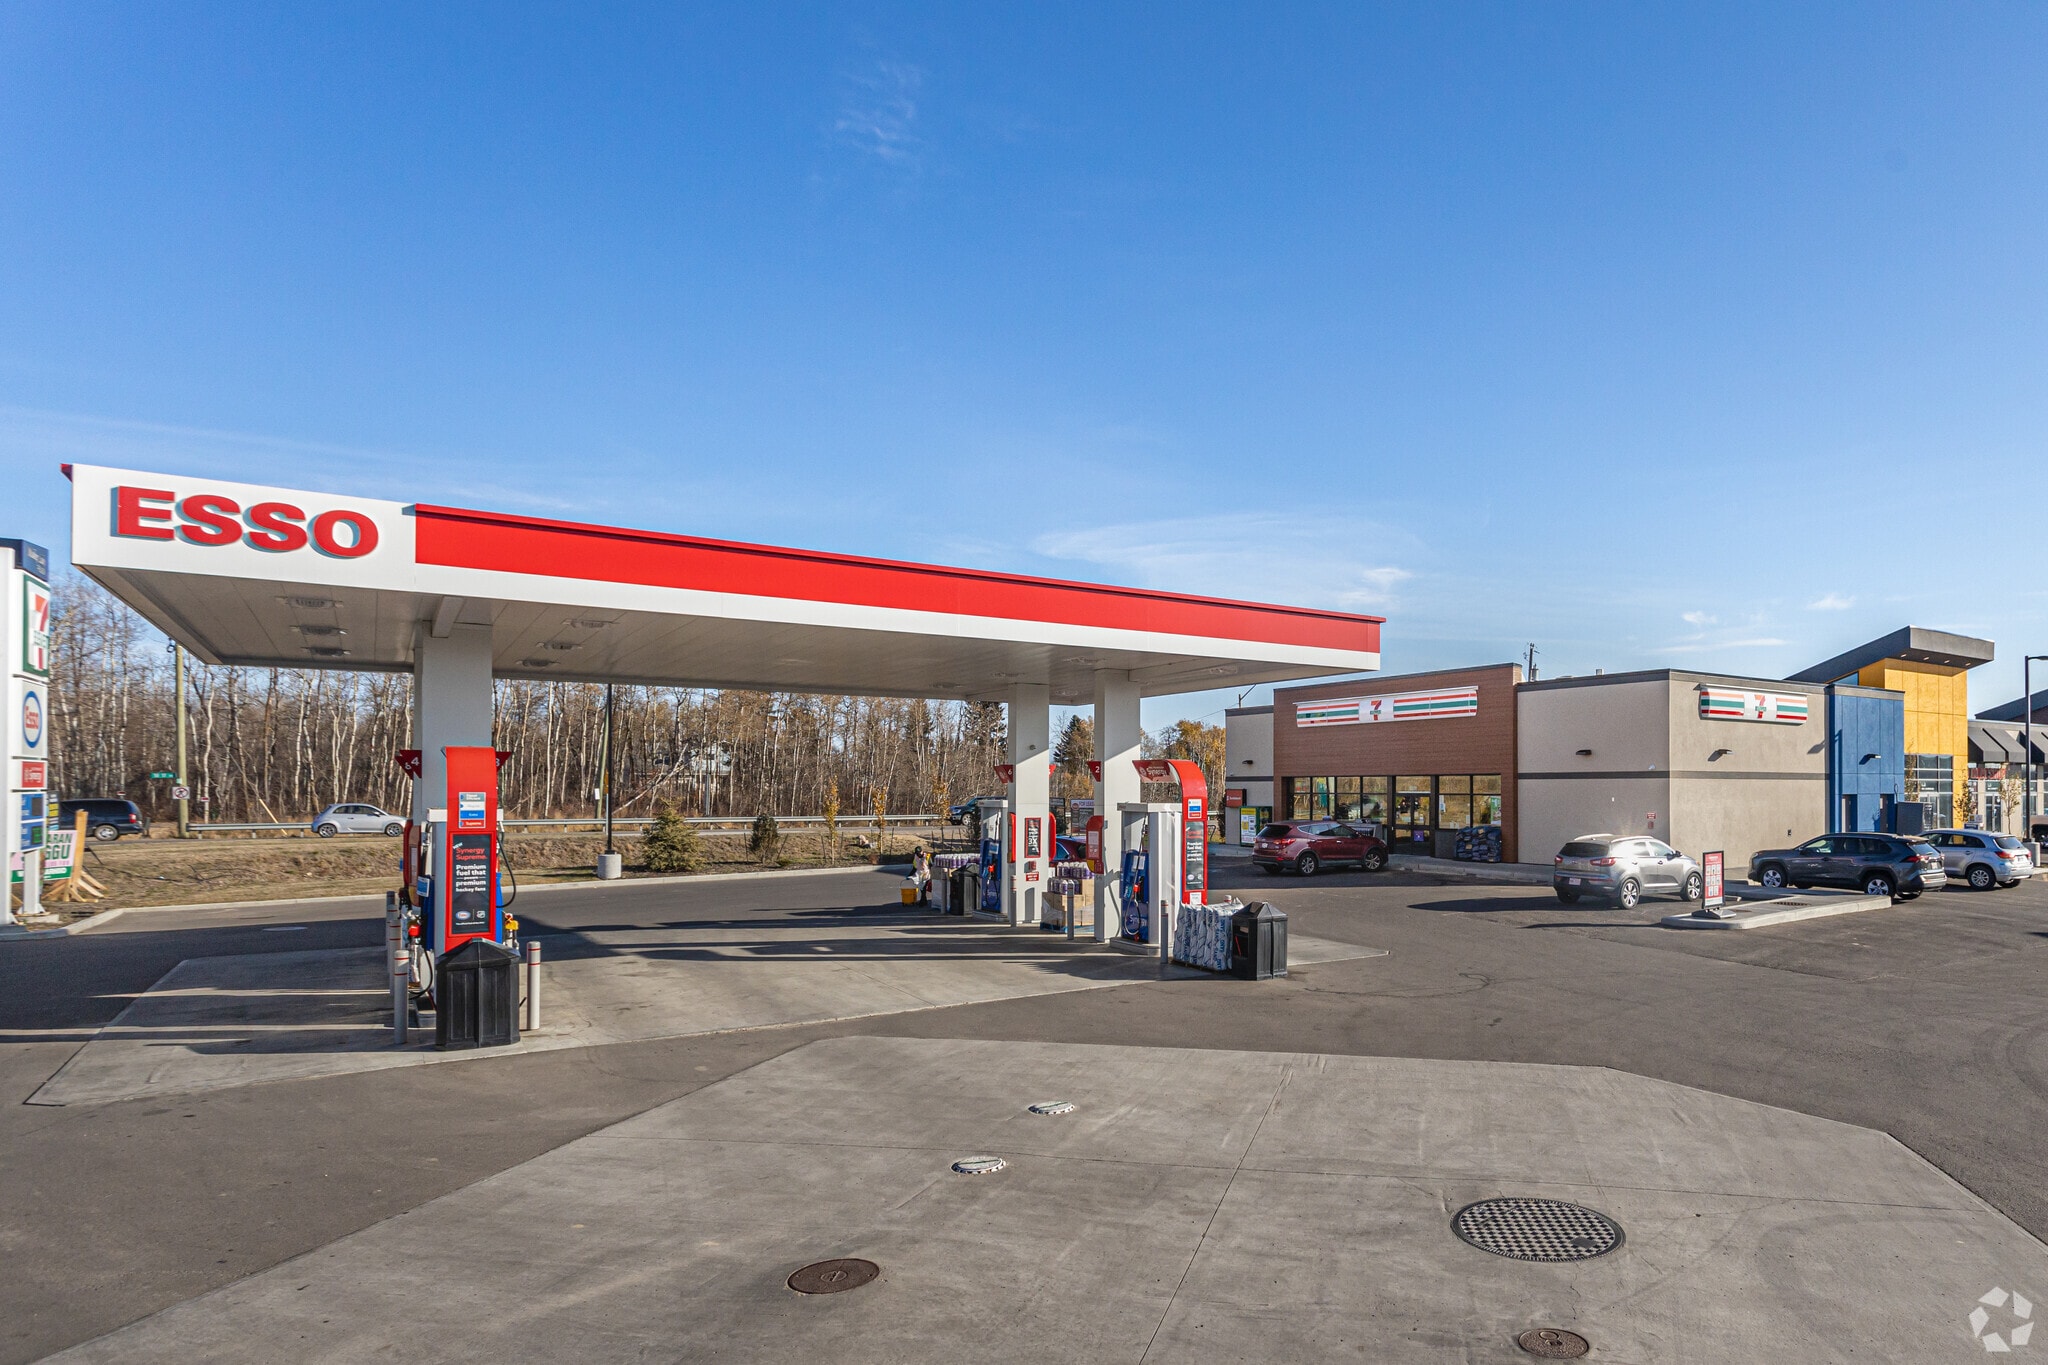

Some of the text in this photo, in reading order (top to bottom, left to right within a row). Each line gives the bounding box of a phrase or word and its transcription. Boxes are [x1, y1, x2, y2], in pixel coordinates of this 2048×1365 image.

[110, 485, 379, 560] ESSO
[35, 594, 48, 670] 7
[1370, 699, 1382, 721] 7
[1754, 694, 1766, 719] 7
[405, 762, 412, 770] 6
[411, 757, 419, 766] 4
[1095, 766, 1100, 774] 2
